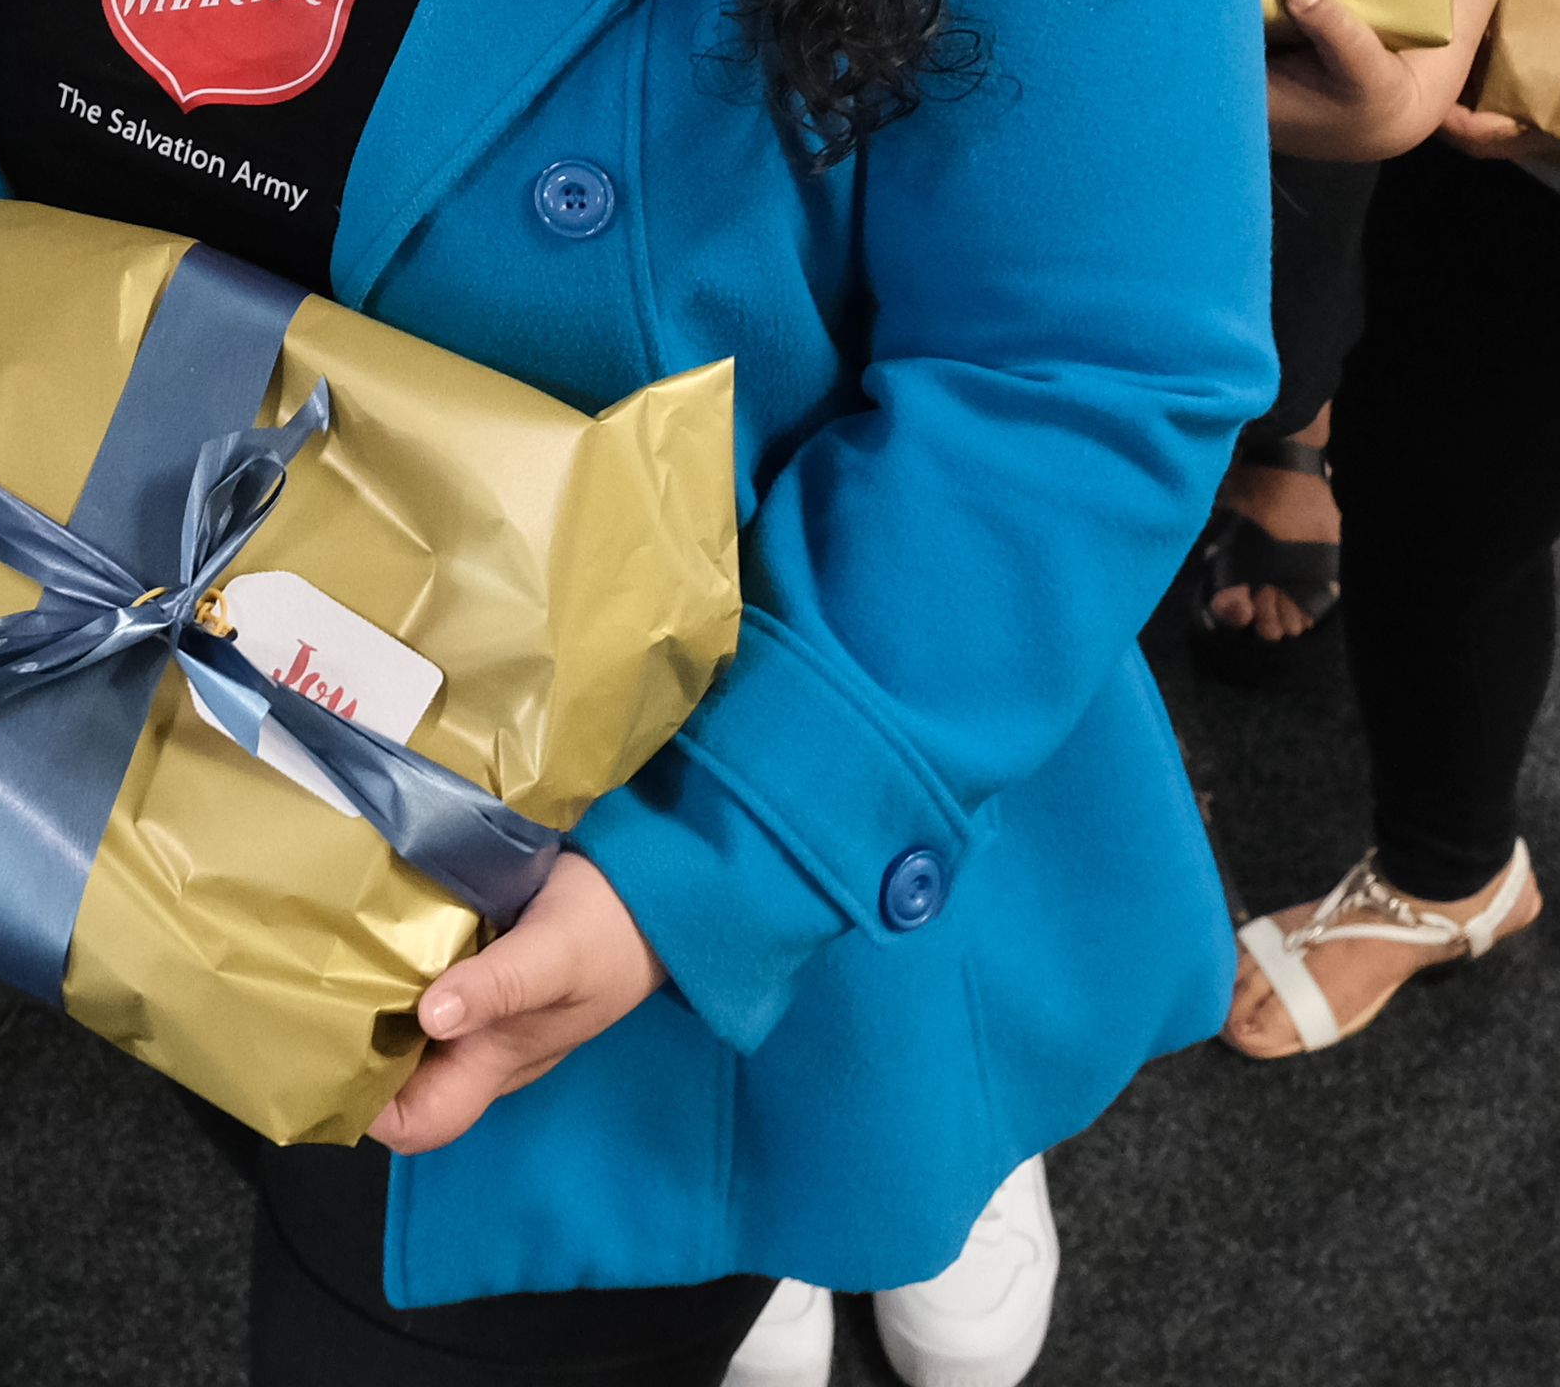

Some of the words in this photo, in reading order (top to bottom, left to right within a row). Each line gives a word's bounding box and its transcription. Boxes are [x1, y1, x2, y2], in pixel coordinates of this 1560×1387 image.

[57, 81, 102, 125] The
[106, 108, 226, 179] Salvation
[231, 160, 310, 212] Army
